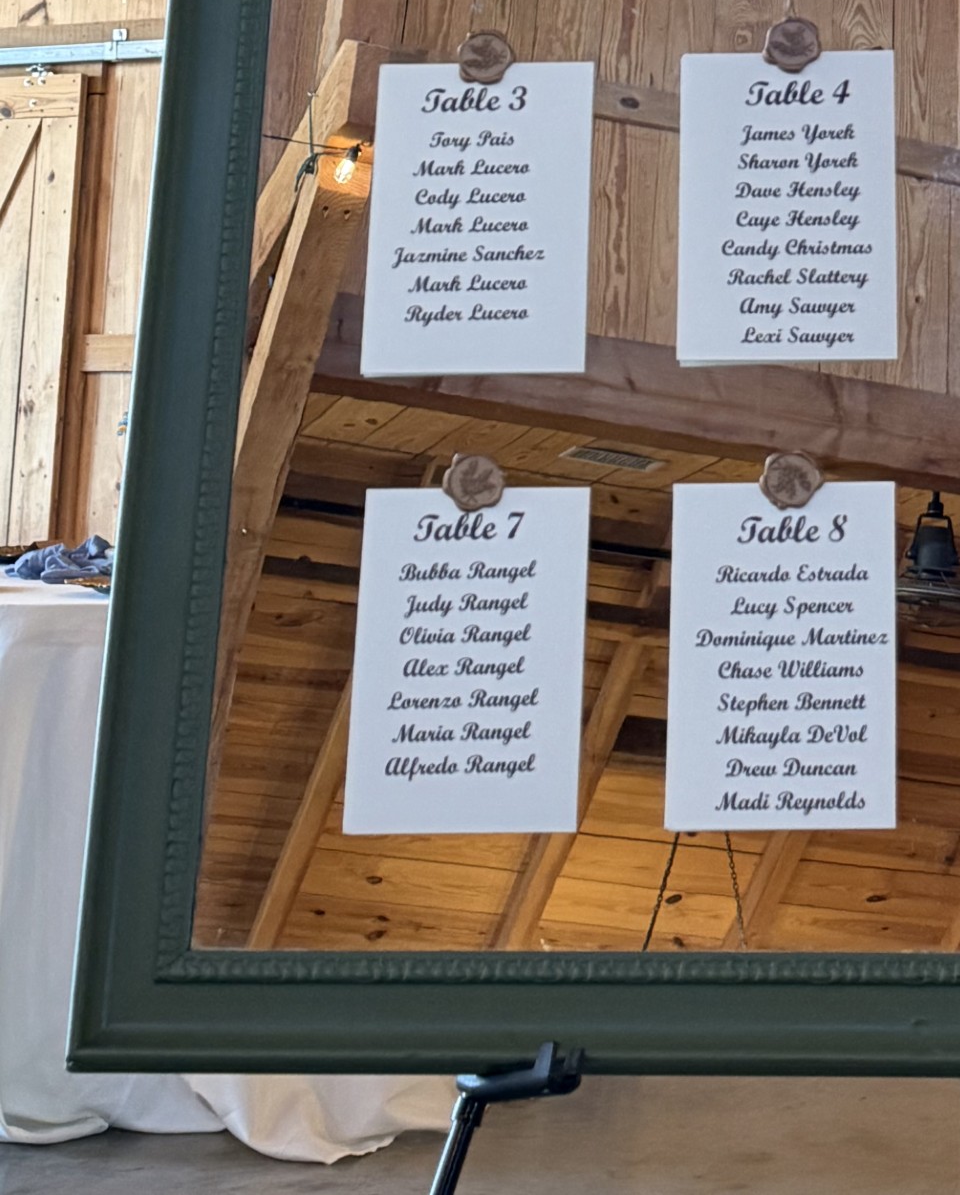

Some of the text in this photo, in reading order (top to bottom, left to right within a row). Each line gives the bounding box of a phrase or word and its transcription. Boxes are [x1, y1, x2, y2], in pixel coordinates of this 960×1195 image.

[421, 86, 527, 113] Table 3
[745, 79, 850, 106] Table 4
[412, 159, 529, 177] Mark Lucero
[415, 188, 526, 209] Cody Lucero
[735, 181, 860, 202] Dave Hensley
[410, 216, 528, 234] Mark Lucero
[722, 239, 872, 260] Candy Christmas
[408, 275, 527, 293] Mark Lucero
[727, 269, 791, 285] Rachel
[404, 304, 528, 327] Ryder Lucero
[739, 297, 855, 319] Amy Sawyer
[787, 326, 854, 348] Sawyer
[413, 512, 525, 543] Table 7
[737, 515, 847, 544] Table 8
[399, 560, 536, 583] Bubba Rangel
[716, 563, 869, 583] Ricardo Estrada
[404, 592, 528, 619] Judy Rangel
[730, 596, 854, 619] Lucy Spencer
[399, 623, 531, 647] Olivia Rangel
[695, 627, 888, 652] Dominique Martinez
[718, 660, 864, 679] Chase Williams
[392, 721, 531, 745] Maria Rangel
[385, 754, 536, 781] Alfredo Rangel
[725, 758, 857, 777] Drew Duncan
[715, 791, 866, 816] Madi Reynolds
